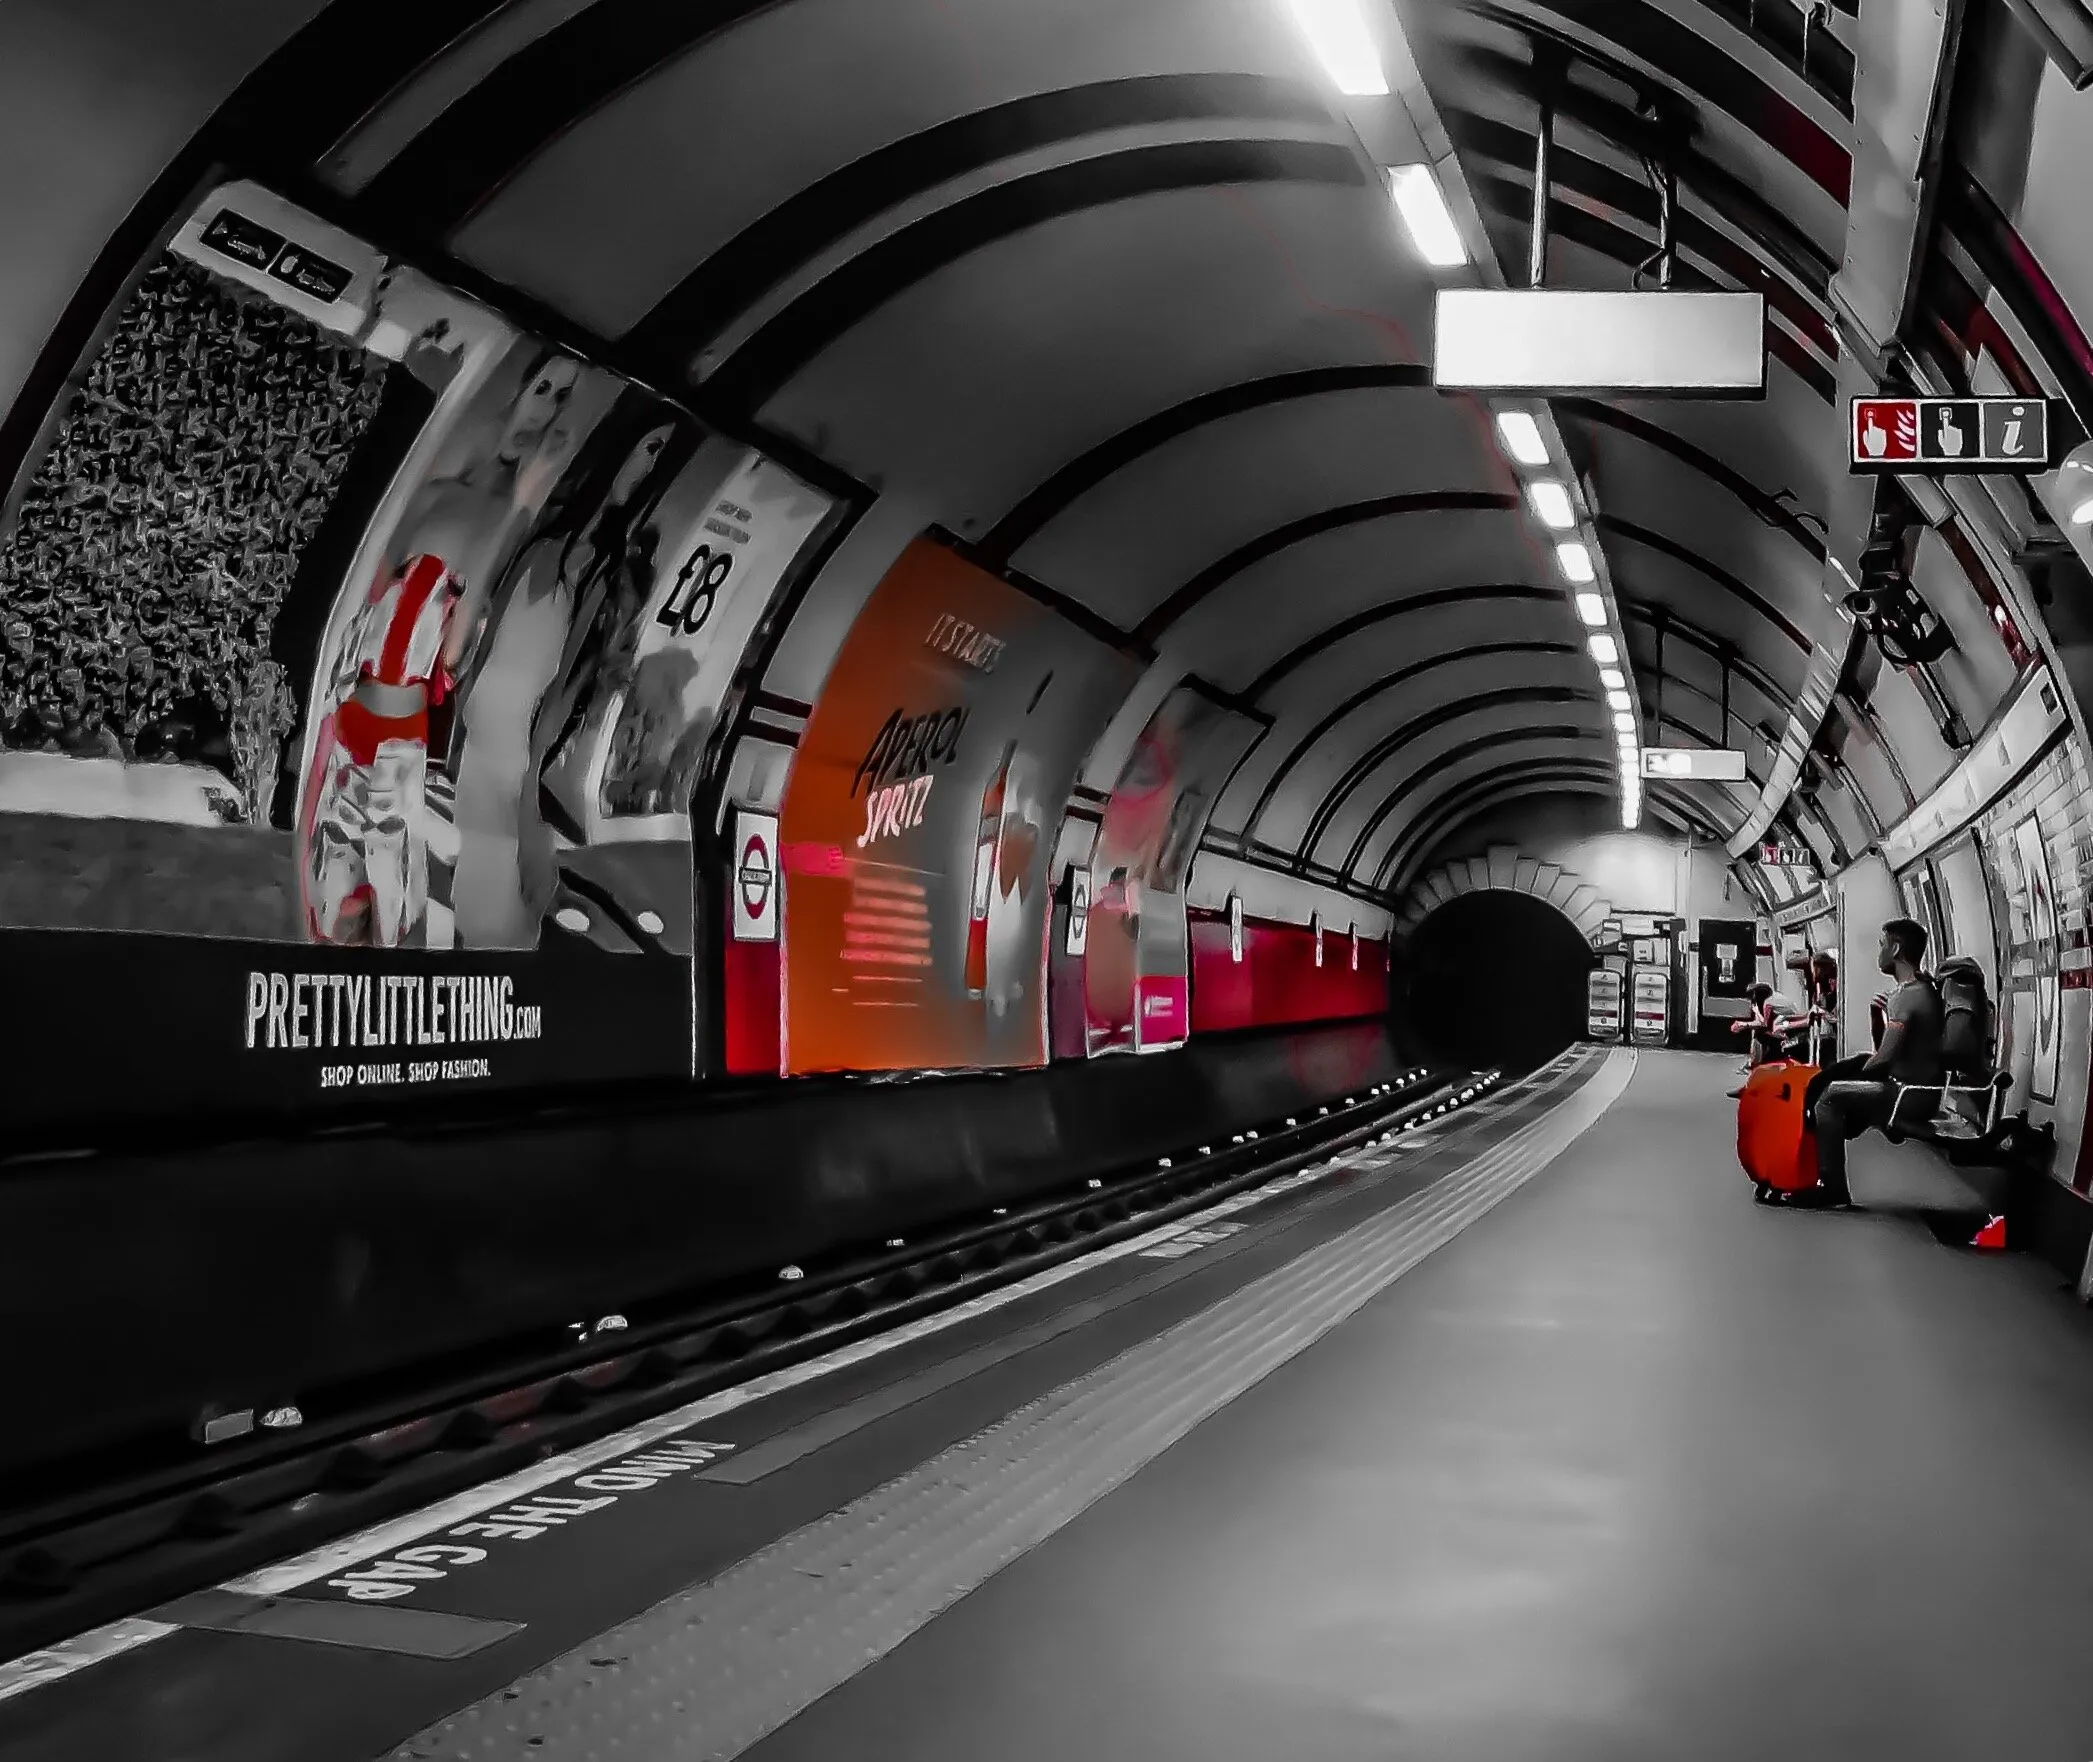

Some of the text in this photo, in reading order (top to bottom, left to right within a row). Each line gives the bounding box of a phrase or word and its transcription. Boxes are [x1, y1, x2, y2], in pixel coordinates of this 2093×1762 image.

[655, 543, 734, 637] £8
[856, 774, 935, 848] SPRITZ
[320, 1058, 492, 1088] SHOP ONLINE. SHOP FASHION.
[327, 1440, 736, 1600] MIND THE GAP
